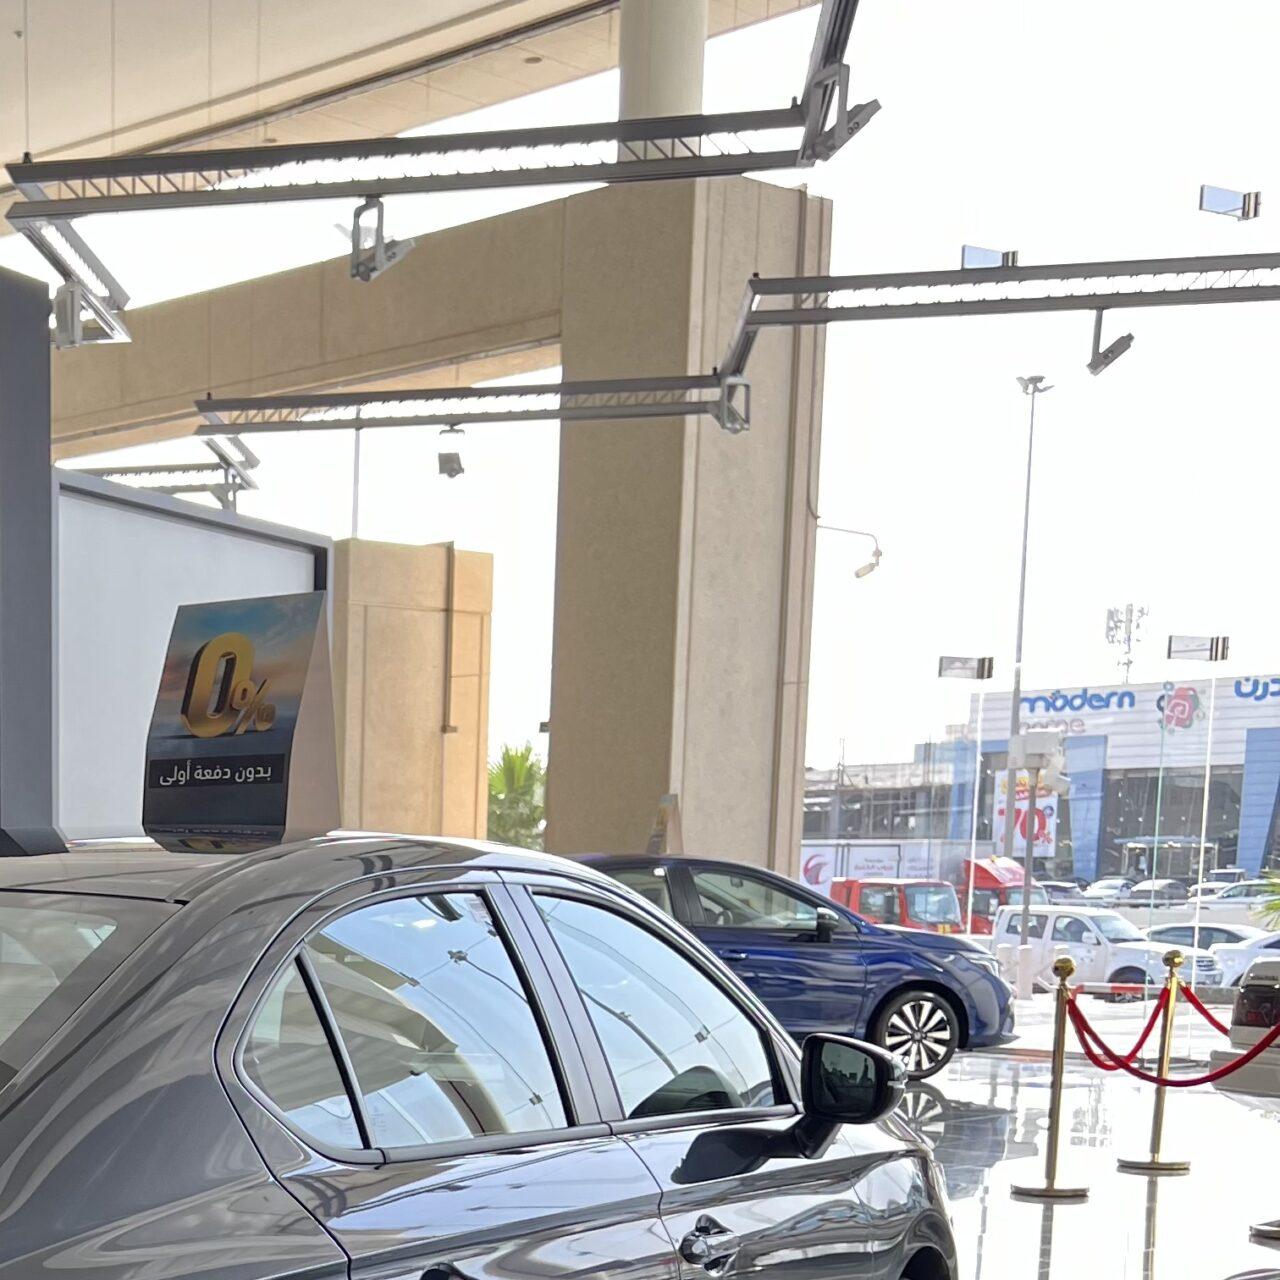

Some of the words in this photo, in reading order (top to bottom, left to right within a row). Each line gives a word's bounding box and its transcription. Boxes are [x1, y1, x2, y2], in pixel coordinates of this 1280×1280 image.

[180, 631, 277, 739] 0%
[159, 759, 192, 786] أولى
[194, 765, 231, 780] دفعة
[235, 766, 272, 783] بدون
